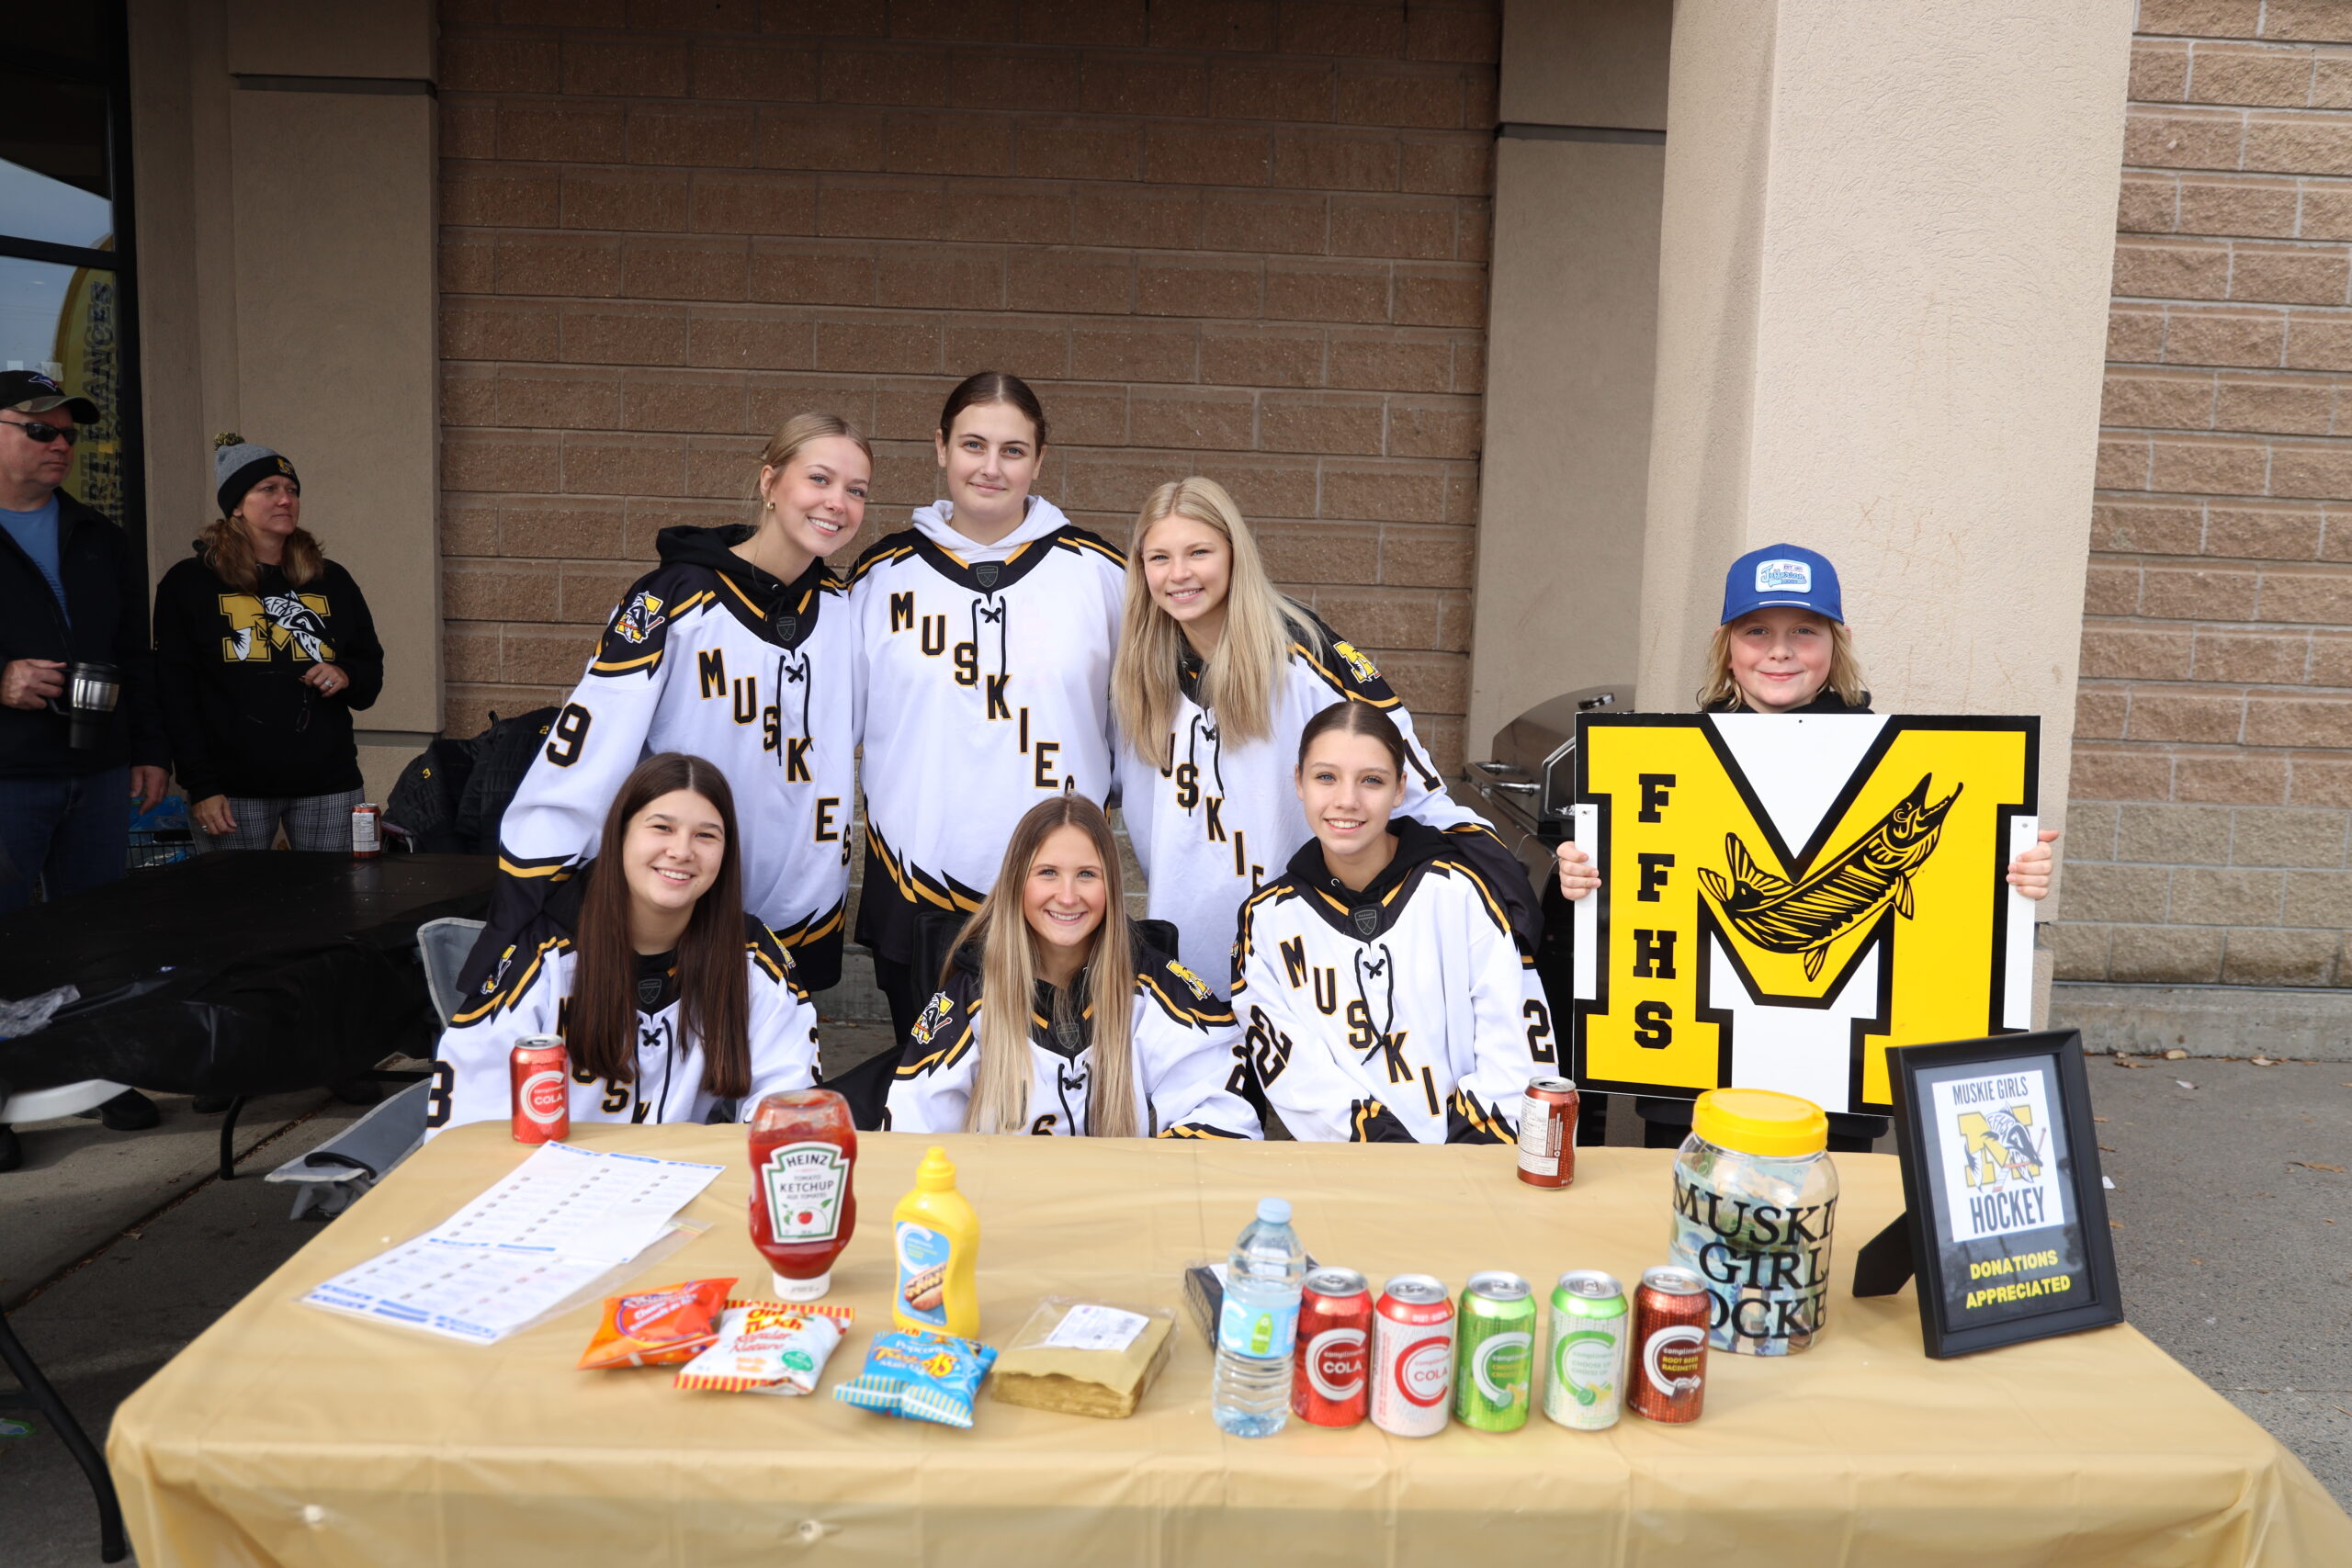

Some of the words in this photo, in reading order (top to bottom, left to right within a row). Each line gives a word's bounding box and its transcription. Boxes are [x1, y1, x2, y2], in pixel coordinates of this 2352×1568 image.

[545, 702, 593, 768] 9
[697, 647, 852, 866] MUSKES
[1632, 773, 1677, 1050] FFHS
[1279, 933, 1442, 1117] MUSKI
[1245, 1004, 1294, 1089] 22
[534, 1094, 563, 1106] COLA
[1952, 1079, 1996, 1106] MUSKIE
[1996, 1076, 2029, 1098] GIRLS
[786, 1154, 830, 1168] HEINZ
[780, 1180, 835, 1193] KETCHUP
[1673, 1172, 1838, 1246] MUSKI
[1969, 1186, 2047, 1235] HOCKEY
[1698, 1242, 1832, 1291] GIRL
[1970, 1249, 2059, 1280] DONATIONS
[1965, 1274, 2072, 1310] APPRECIATED
[1706, 1288, 1828, 1340] OCKE
[1323, 1359, 1363, 1375] COLA
[1414, 1367, 1449, 1382] COLA
[1661, 1364, 1699, 1372] RACINETTE
[1662, 1356, 1683, 1365] ROOT
[1683, 1356, 1699, 1365] BEER
